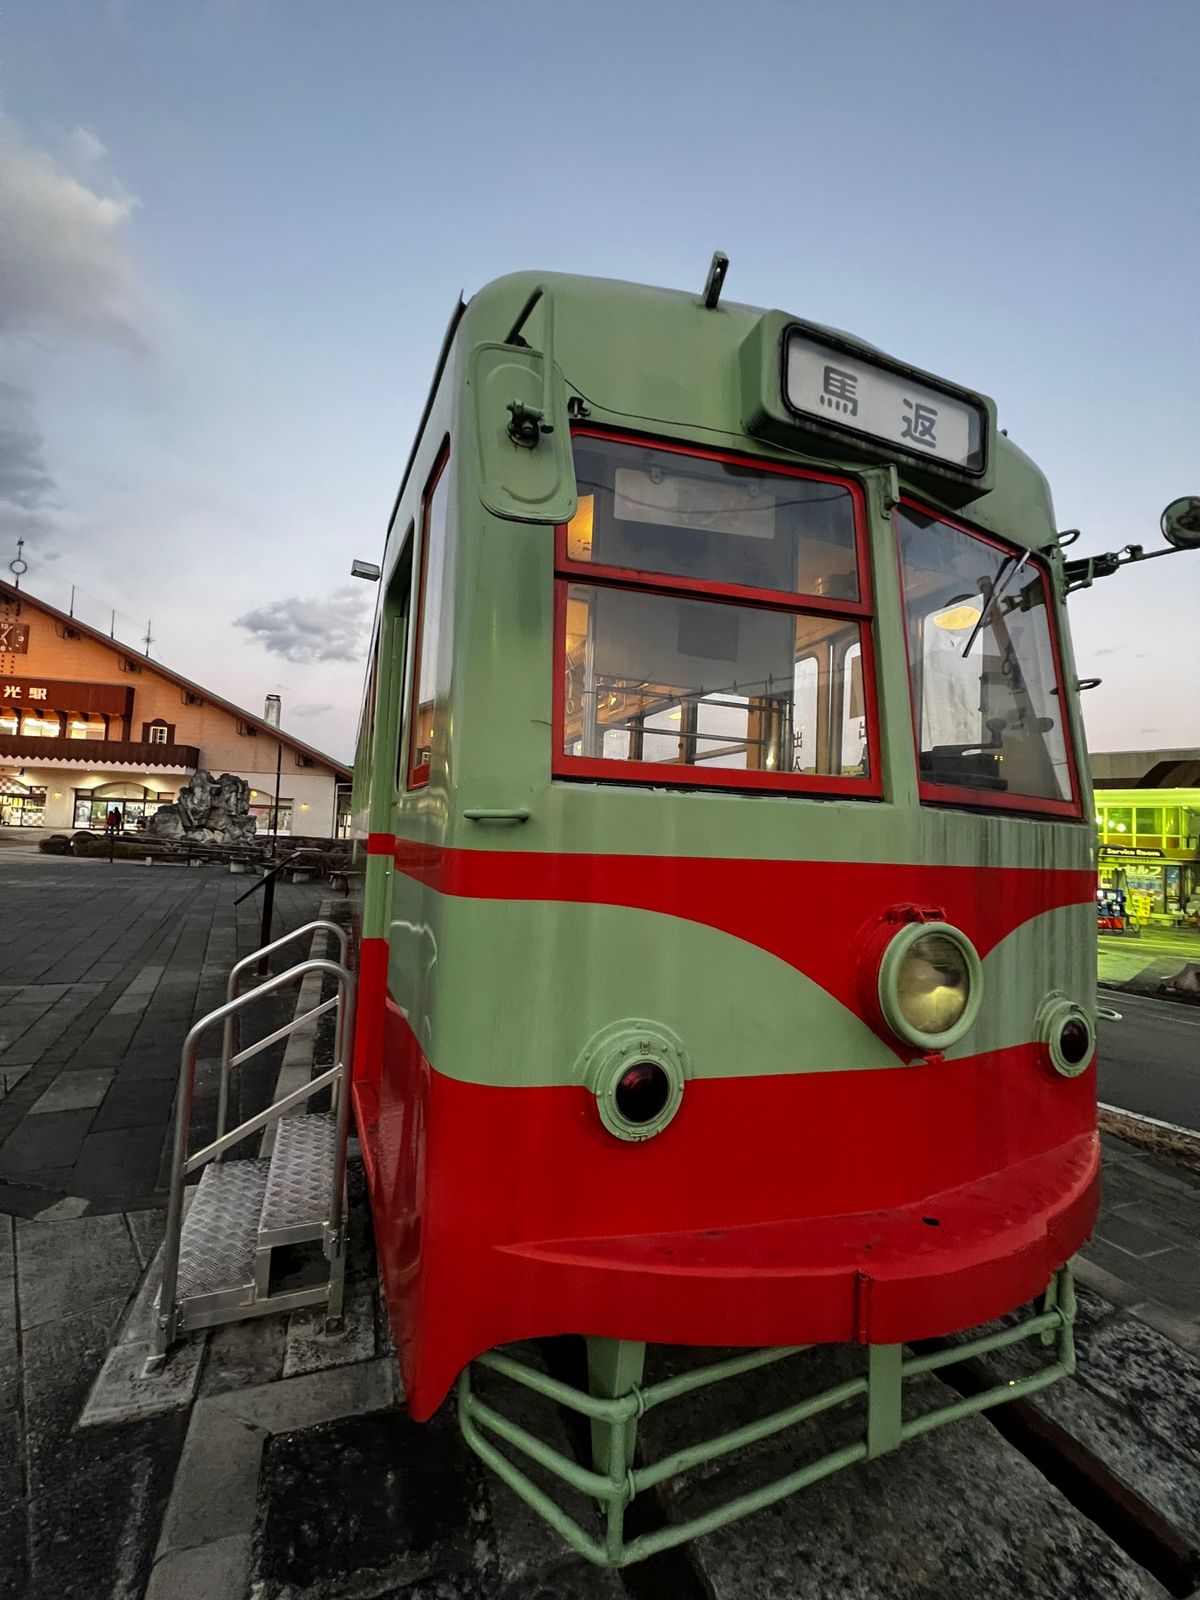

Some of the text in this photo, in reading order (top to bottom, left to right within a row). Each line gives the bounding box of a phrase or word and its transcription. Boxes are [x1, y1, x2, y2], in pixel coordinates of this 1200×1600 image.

[820, 365, 938, 449] 馬返
[3, 685, 47, 700] 光駅
[1125, 864, 1162, 875] セルフ
